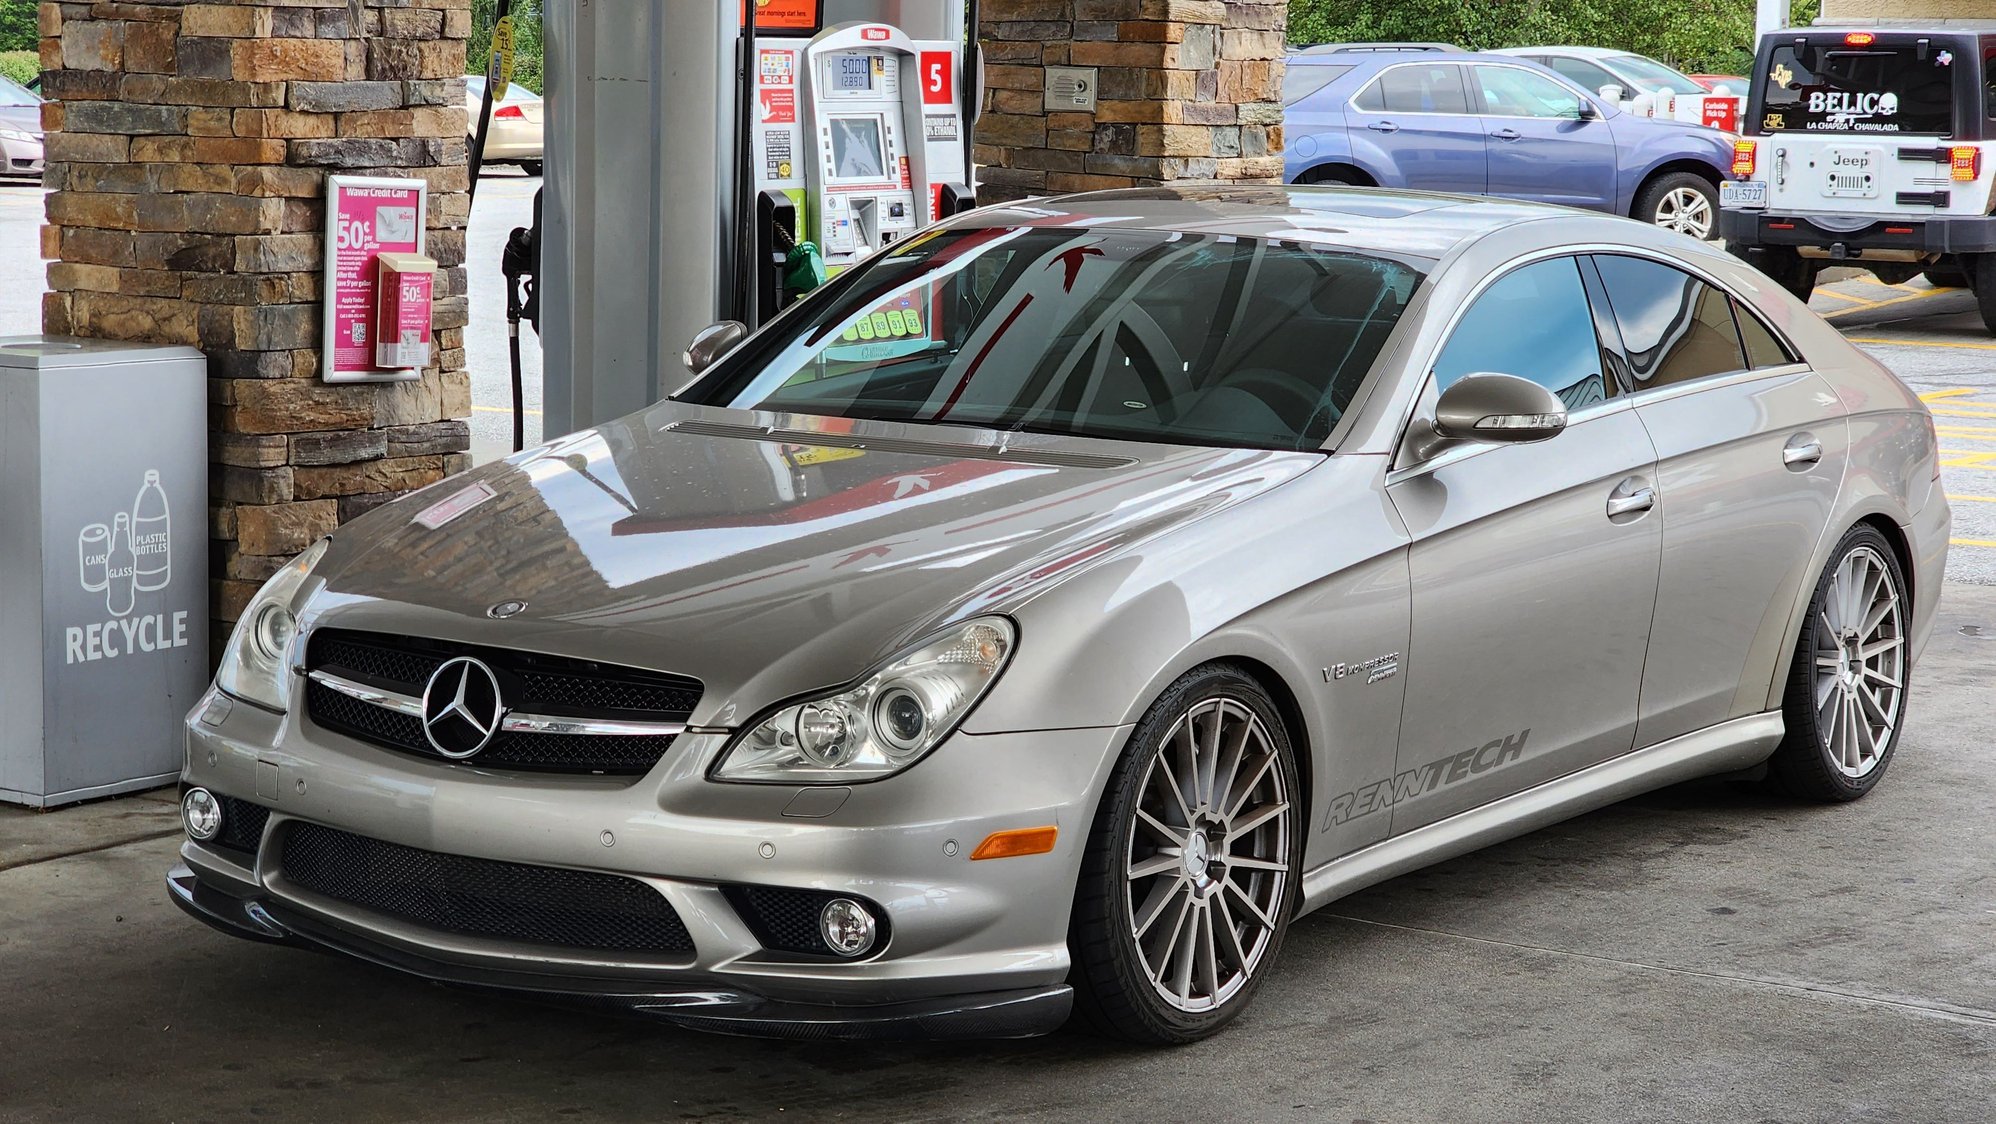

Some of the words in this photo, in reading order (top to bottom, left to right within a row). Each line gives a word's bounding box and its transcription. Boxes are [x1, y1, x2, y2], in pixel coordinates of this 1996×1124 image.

[867, 29, 886, 40] Wawa
[930, 64, 942, 92] 5
[1705, 102, 1728, 110] Curbside
[1717, 110, 1727, 118] Up
[935, 126, 956, 136] ETHANOL
[1854, 123, 1899, 131] CHAVALADA
[1833, 155, 1869, 168] Jeep
[370, 188, 391, 198] Credit
[391, 189, 408, 198] Card
[1723, 189, 1762, 200] UDA-5727
[338, 212, 350, 220] Save
[860, 322, 869, 332] 87
[875, 321, 886, 330] 89
[891, 320, 902, 329] 91
[908, 318, 918, 328] 93
[136, 532, 167, 546] PLASTIC
[136, 543, 167, 556] BOTTLES
[85, 554, 106, 566] CANS
[109, 566, 133, 578] GLASS
[66, 610, 188, 665] RECYCLE
[1322, 662, 1346, 684] V8
[1321, 728, 1531, 834] RENNTECH
